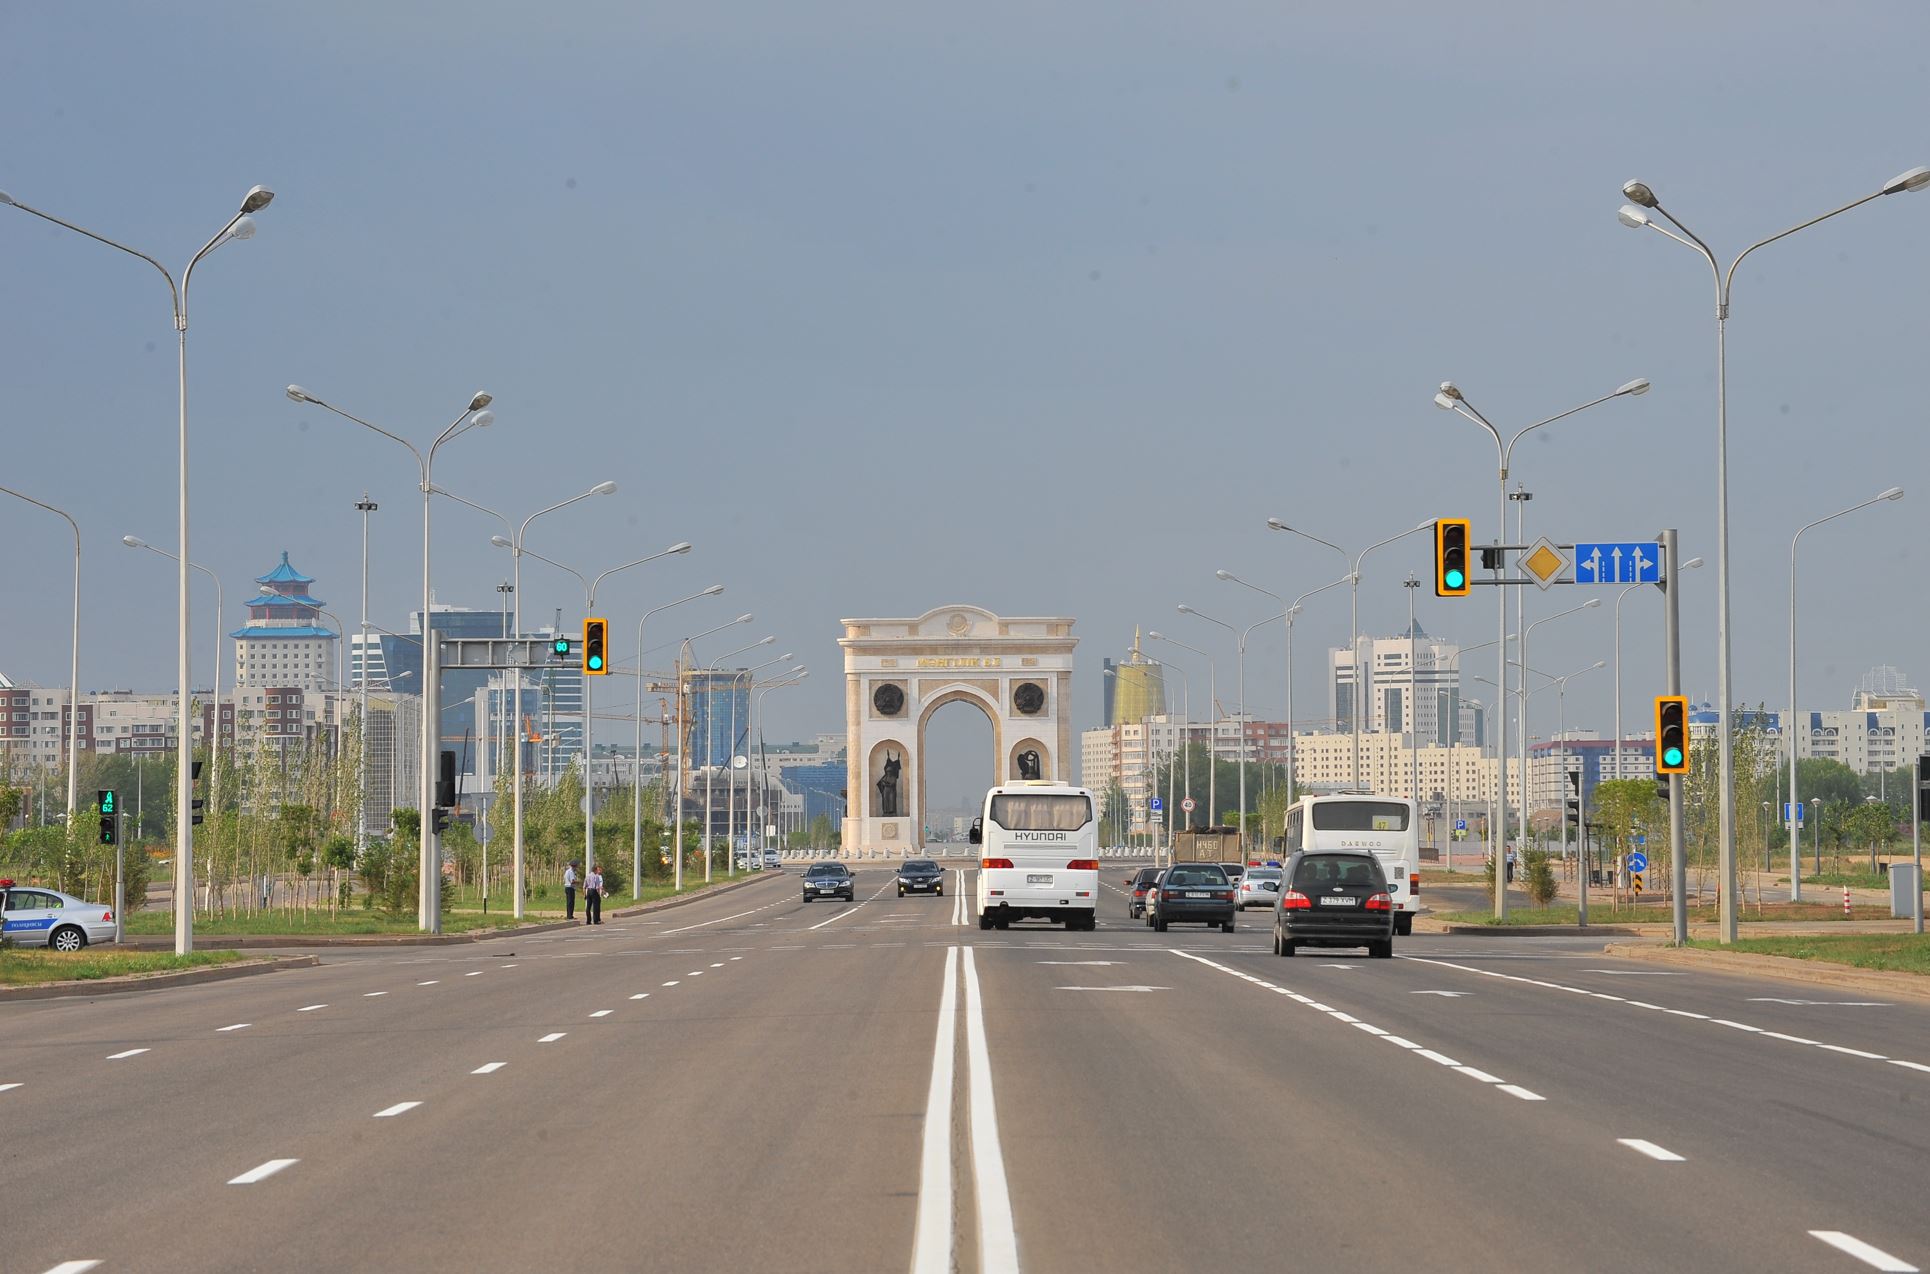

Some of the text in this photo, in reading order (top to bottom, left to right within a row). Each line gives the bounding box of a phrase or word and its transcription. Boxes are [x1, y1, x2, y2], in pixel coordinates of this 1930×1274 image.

[556, 642, 568, 652] 60
[102, 803, 113, 813] 62
[1152, 799, 1160, 809] P
[1015, 832, 1067, 841] HYUNDAI
